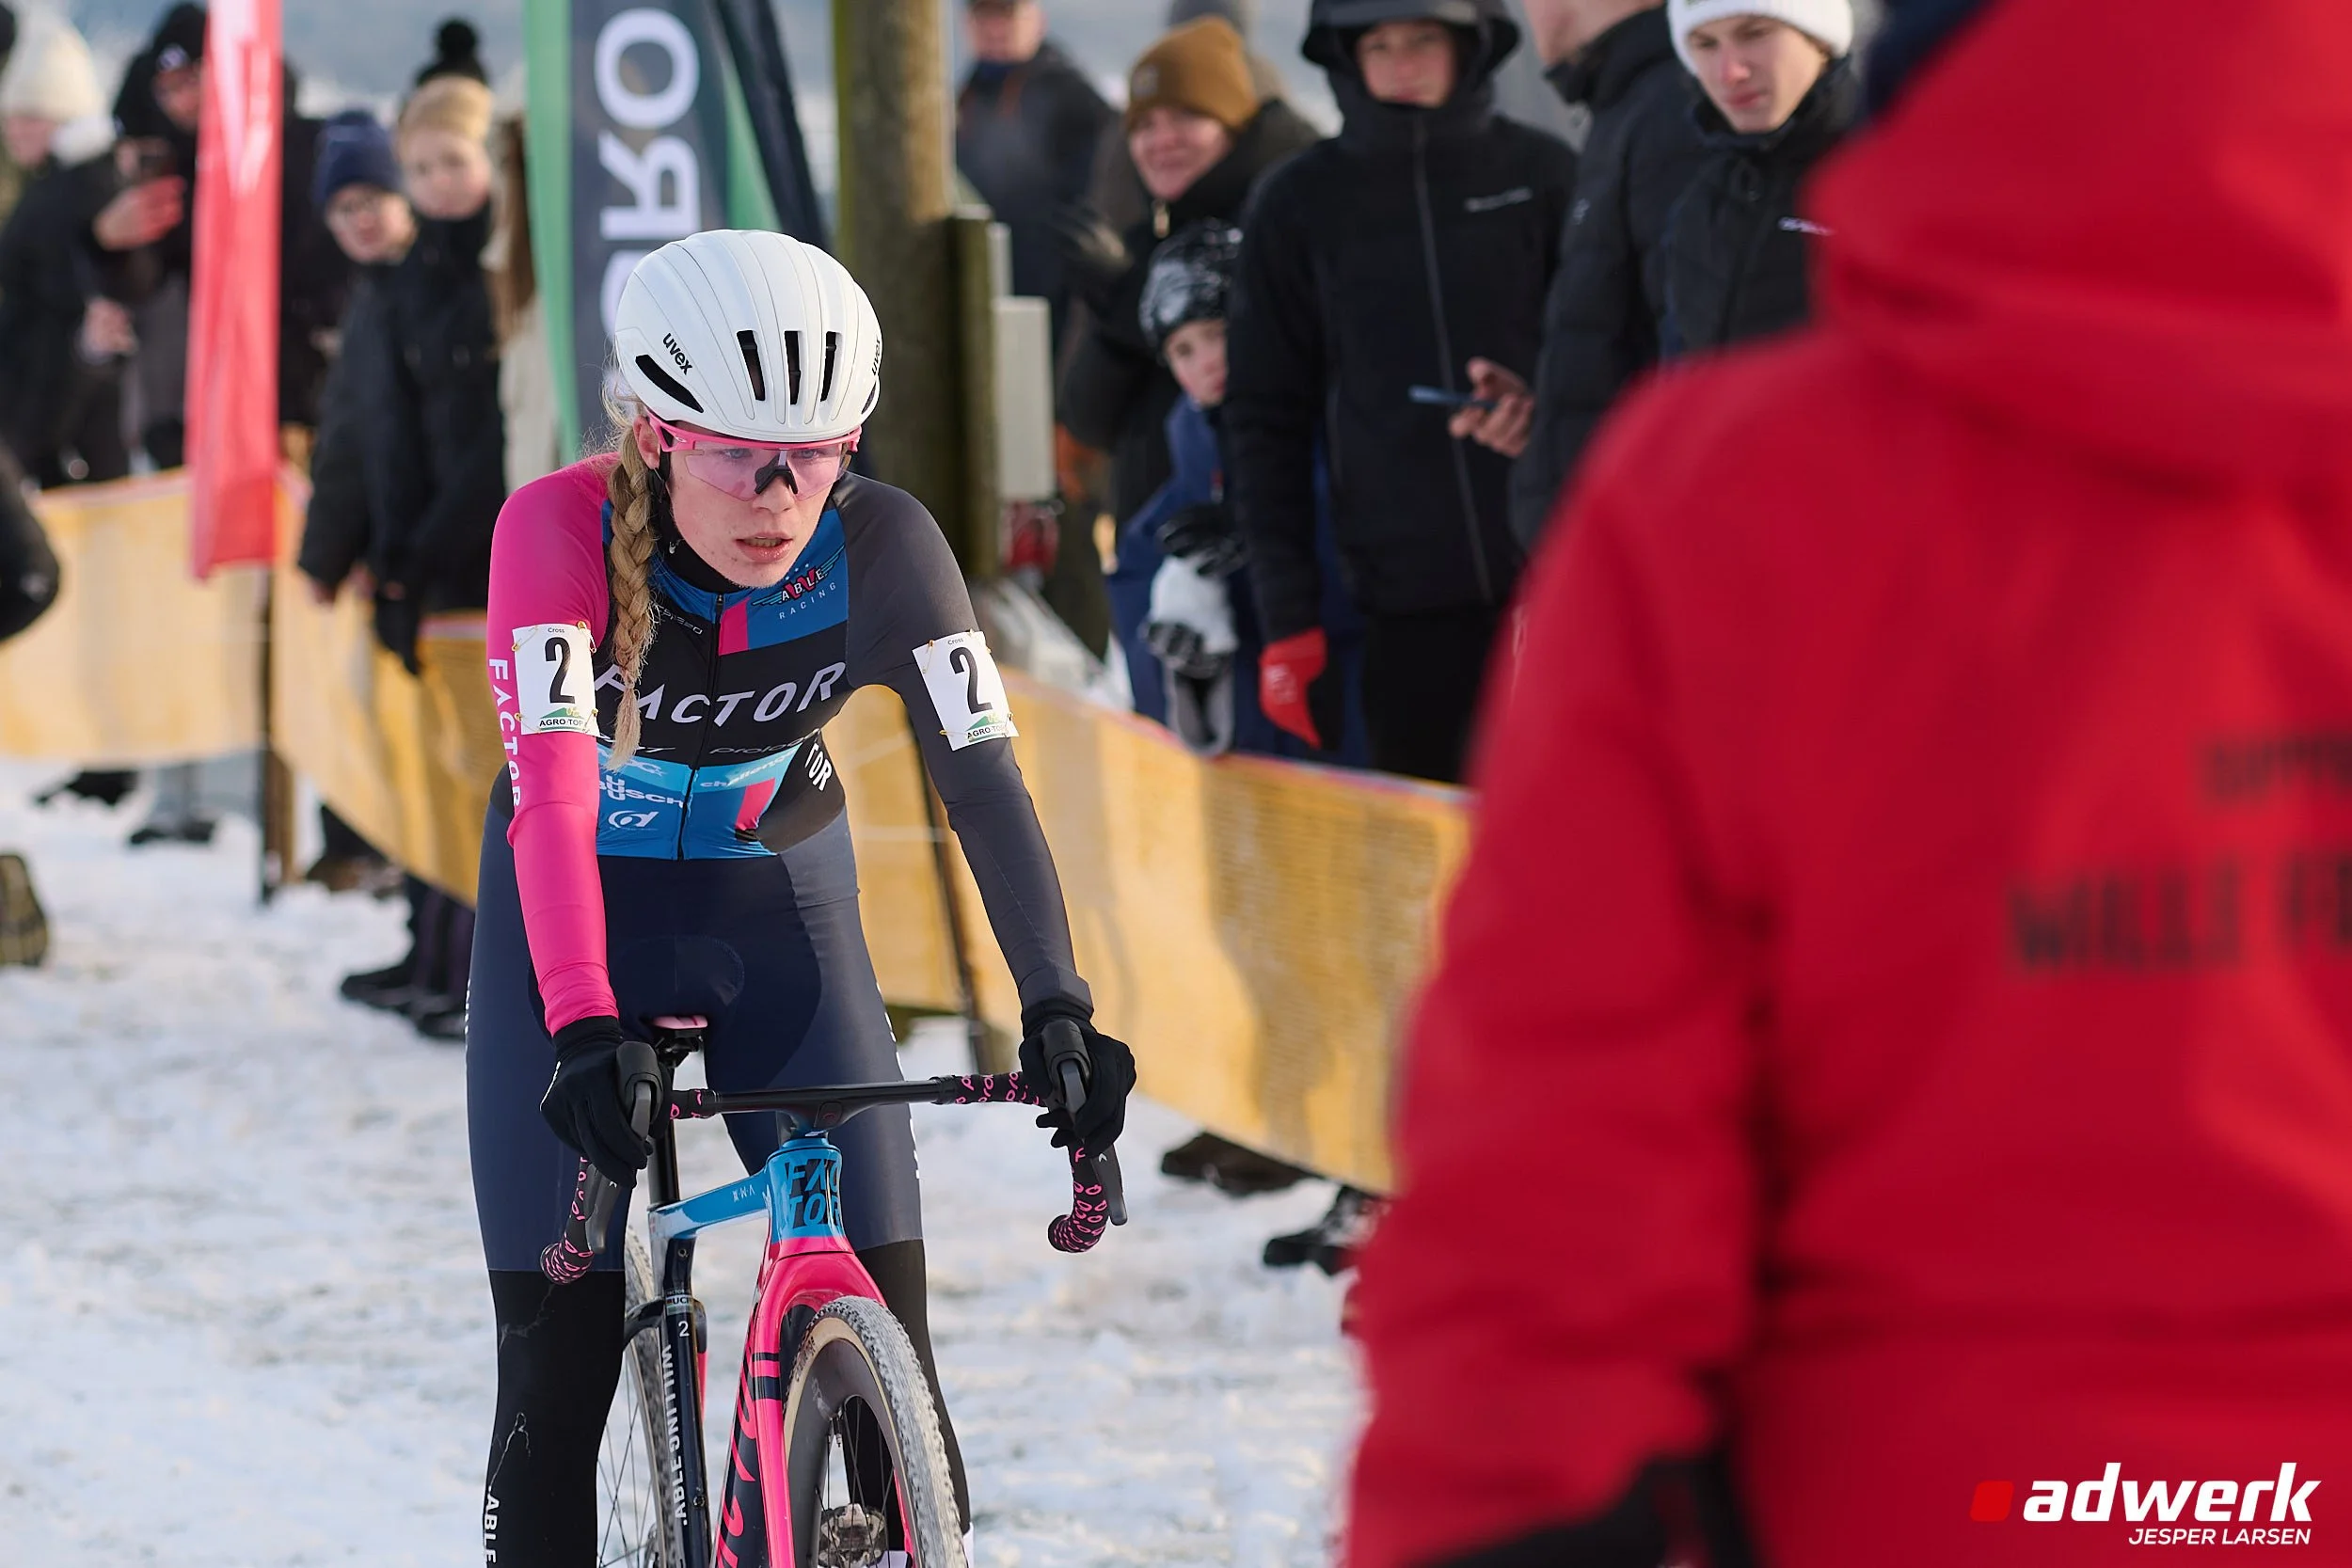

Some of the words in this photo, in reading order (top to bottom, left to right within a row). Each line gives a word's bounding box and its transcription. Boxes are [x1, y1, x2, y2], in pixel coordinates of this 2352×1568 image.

[662, 333, 693, 375] uvex
[779, 582, 836, 620] RACING
[544, 637, 576, 704] 2
[949, 646, 993, 715] 2
[488, 658, 522, 807] FACTOR
[678, 1321, 690, 1338] 2
